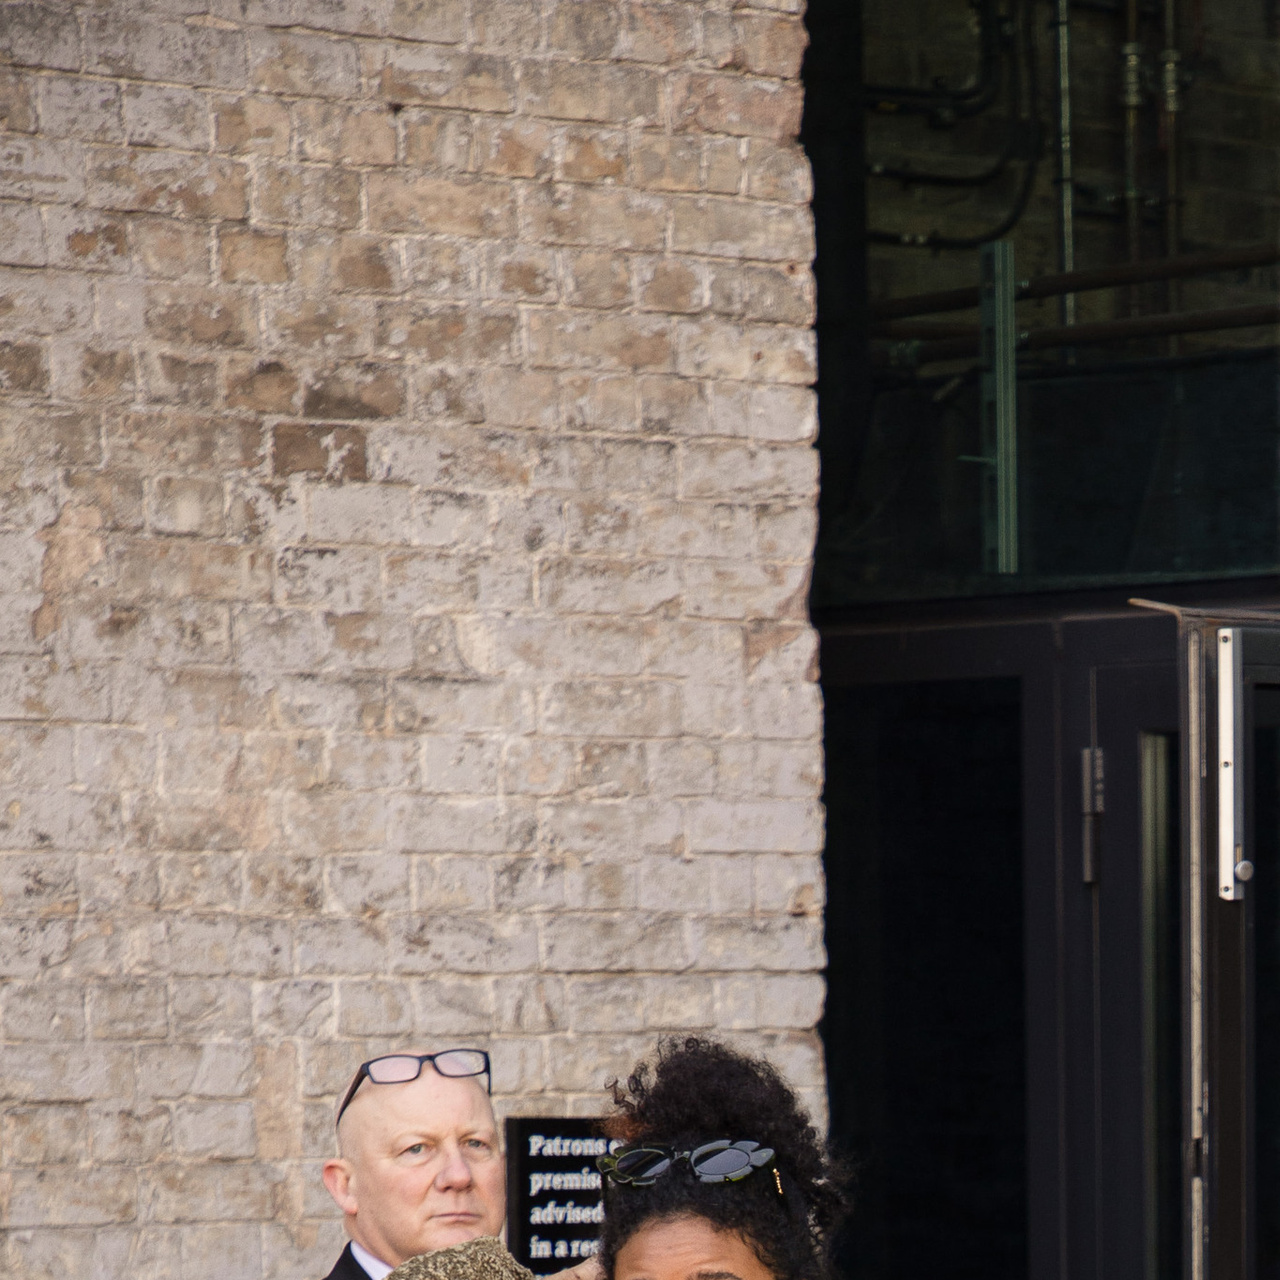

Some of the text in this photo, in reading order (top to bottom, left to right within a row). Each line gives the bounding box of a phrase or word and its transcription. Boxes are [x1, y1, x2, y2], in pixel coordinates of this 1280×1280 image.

[529, 1135, 607, 1156] Patrons
[530, 1199, 605, 1225] advised
[529, 1234, 553, 1259] in
[554, 1240, 569, 1258] a
